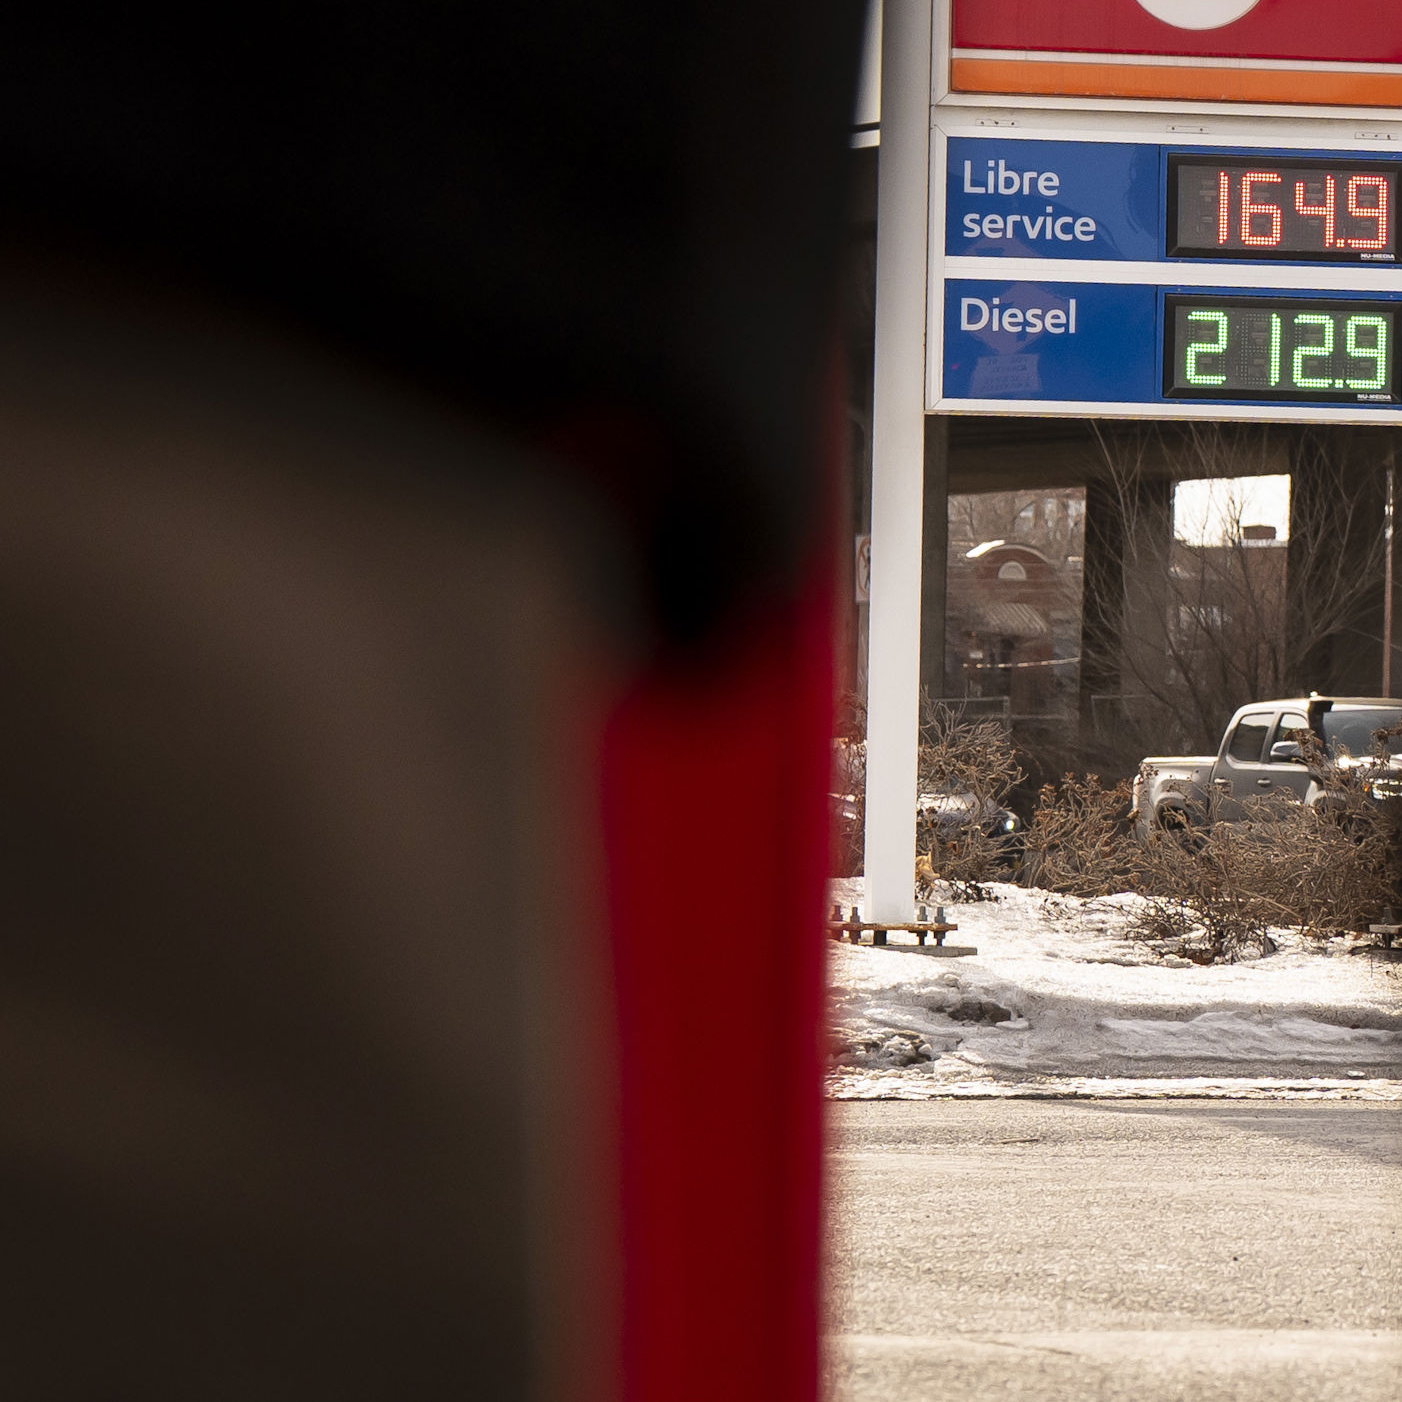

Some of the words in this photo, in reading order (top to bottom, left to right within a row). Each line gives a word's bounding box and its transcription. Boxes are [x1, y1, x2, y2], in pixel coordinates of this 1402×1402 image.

[963, 159, 1060, 197] Libre
[962, 205, 1097, 242] service
[1217, 171, 1389, 250] 164.9
[960, 297, 1077, 334] Diesel
[1186, 310, 1387, 390] 212.9
